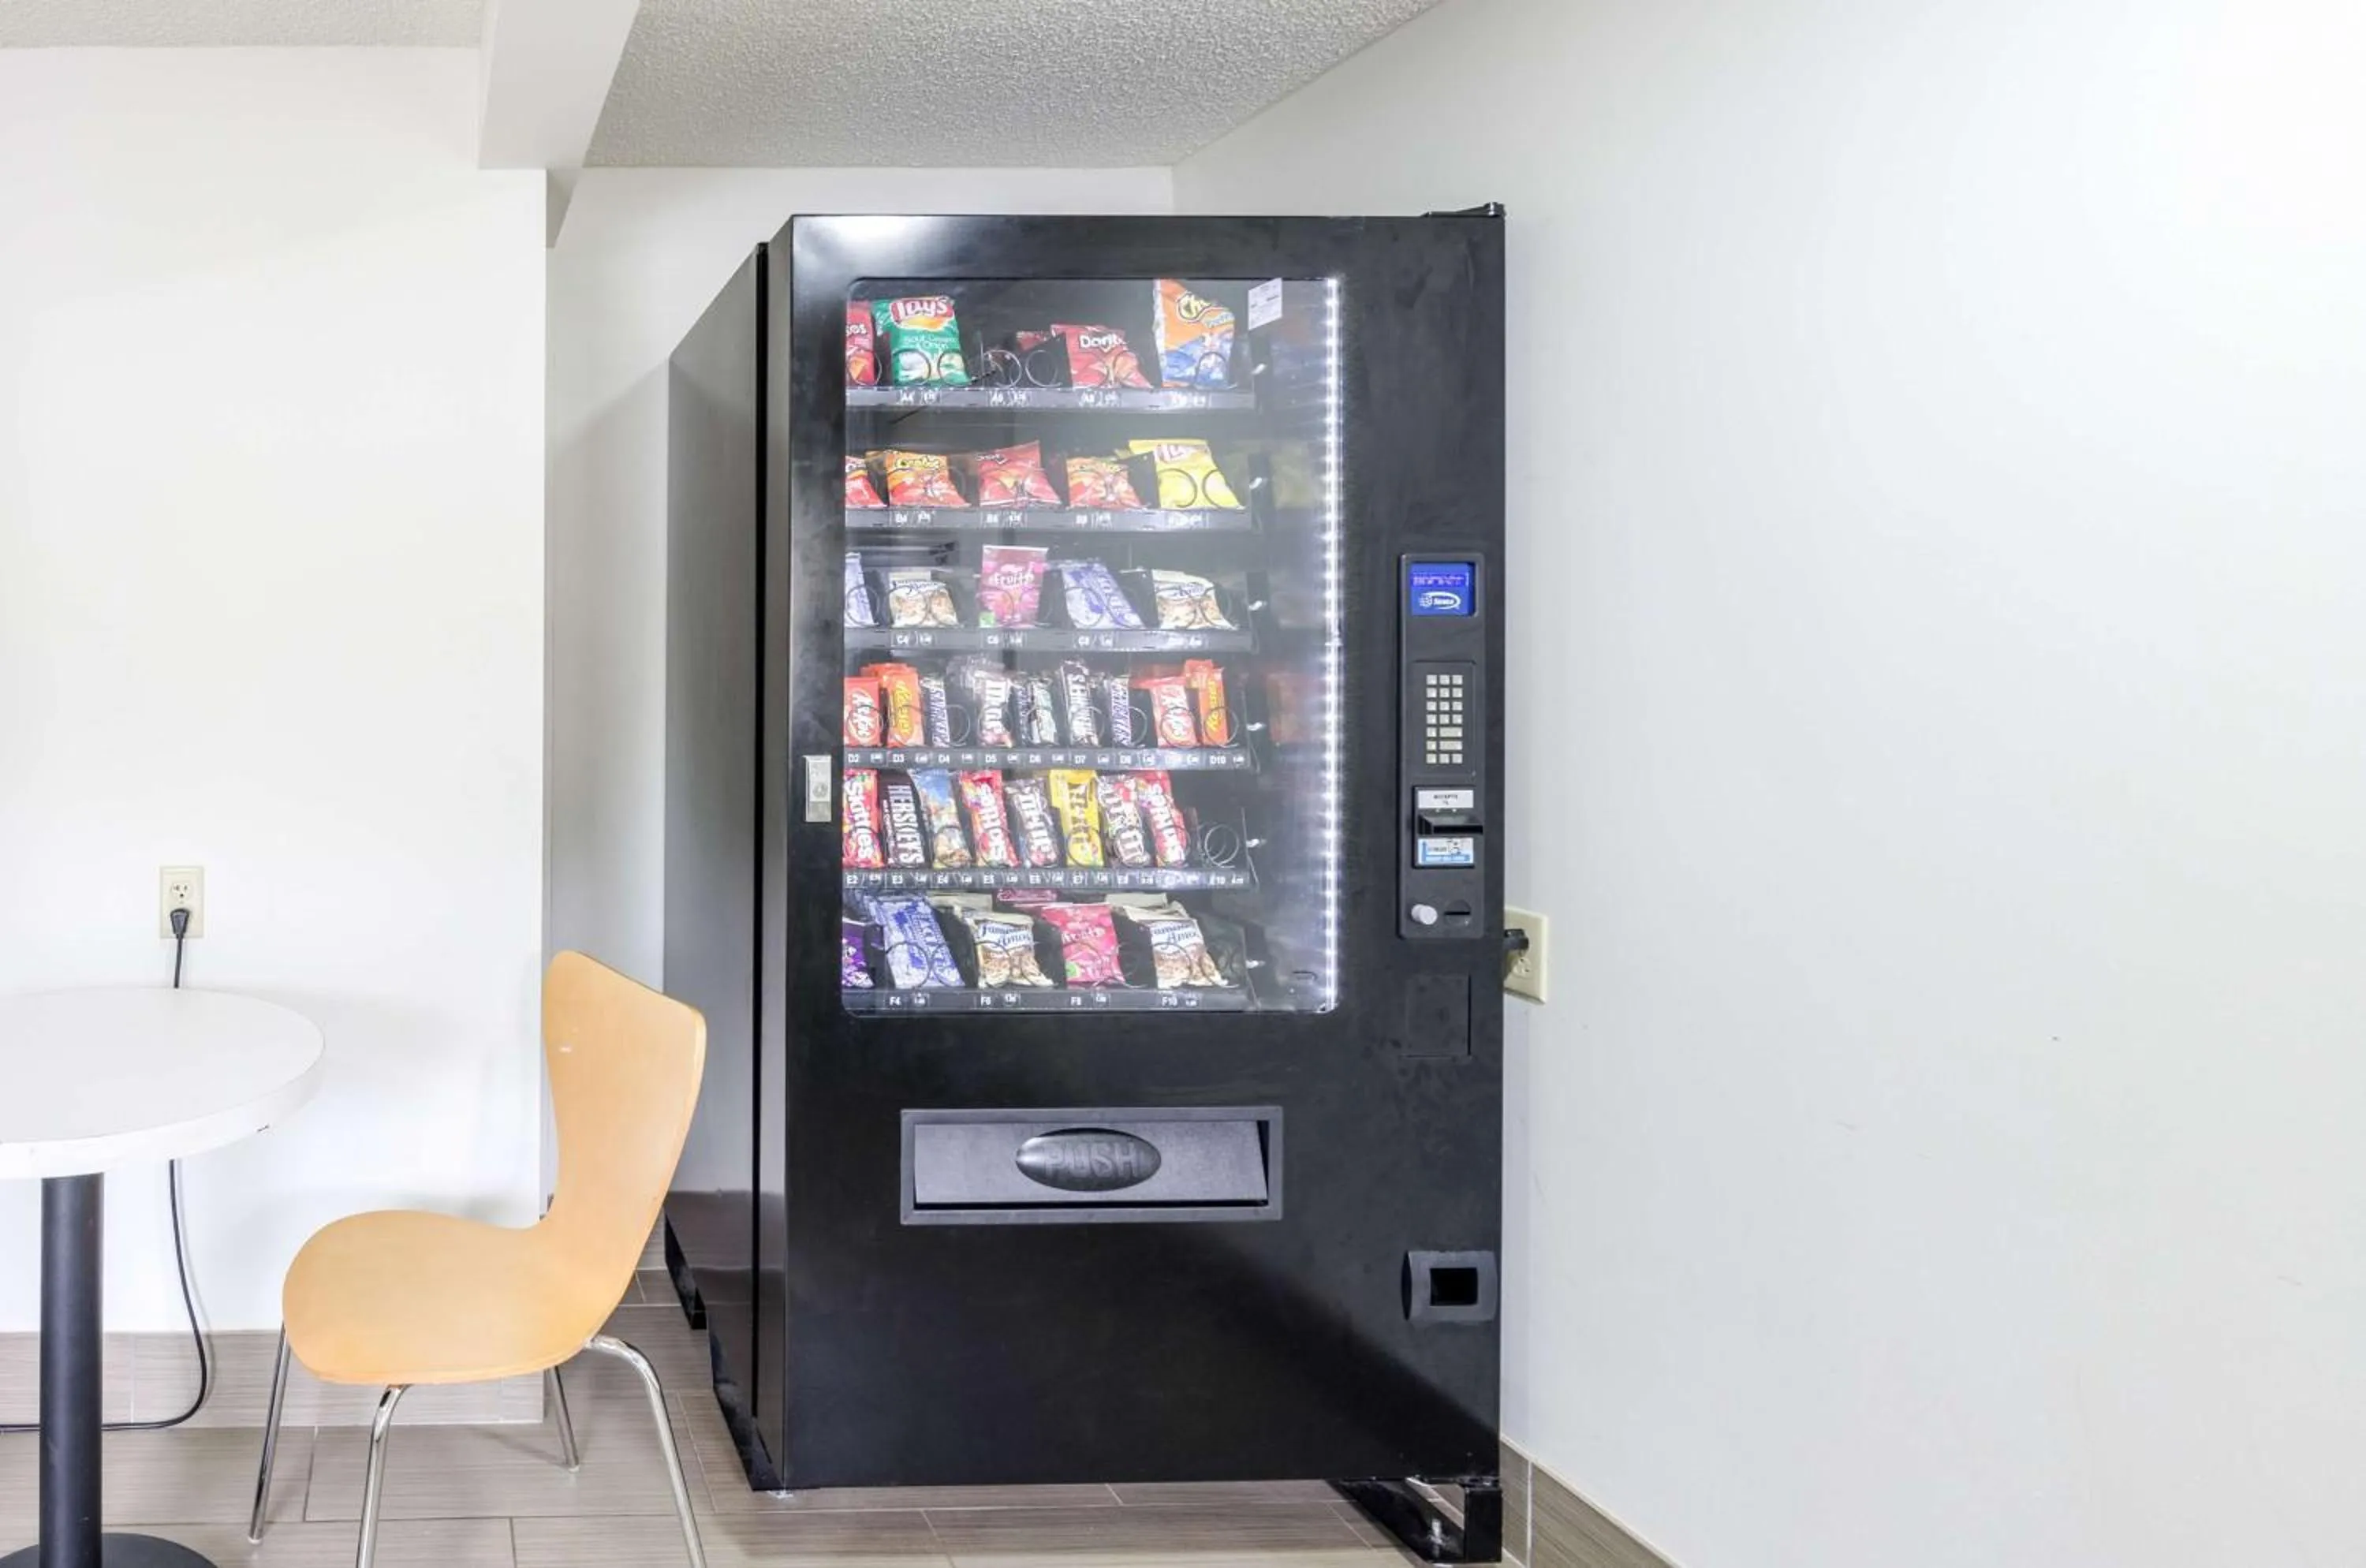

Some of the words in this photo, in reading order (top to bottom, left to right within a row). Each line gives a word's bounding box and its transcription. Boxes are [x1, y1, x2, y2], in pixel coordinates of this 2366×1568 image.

[888, 785, 925, 864] HERSHEY'S
[889, 996, 901, 1006] F4
[1043, 1141, 1140, 1179] PUSH
